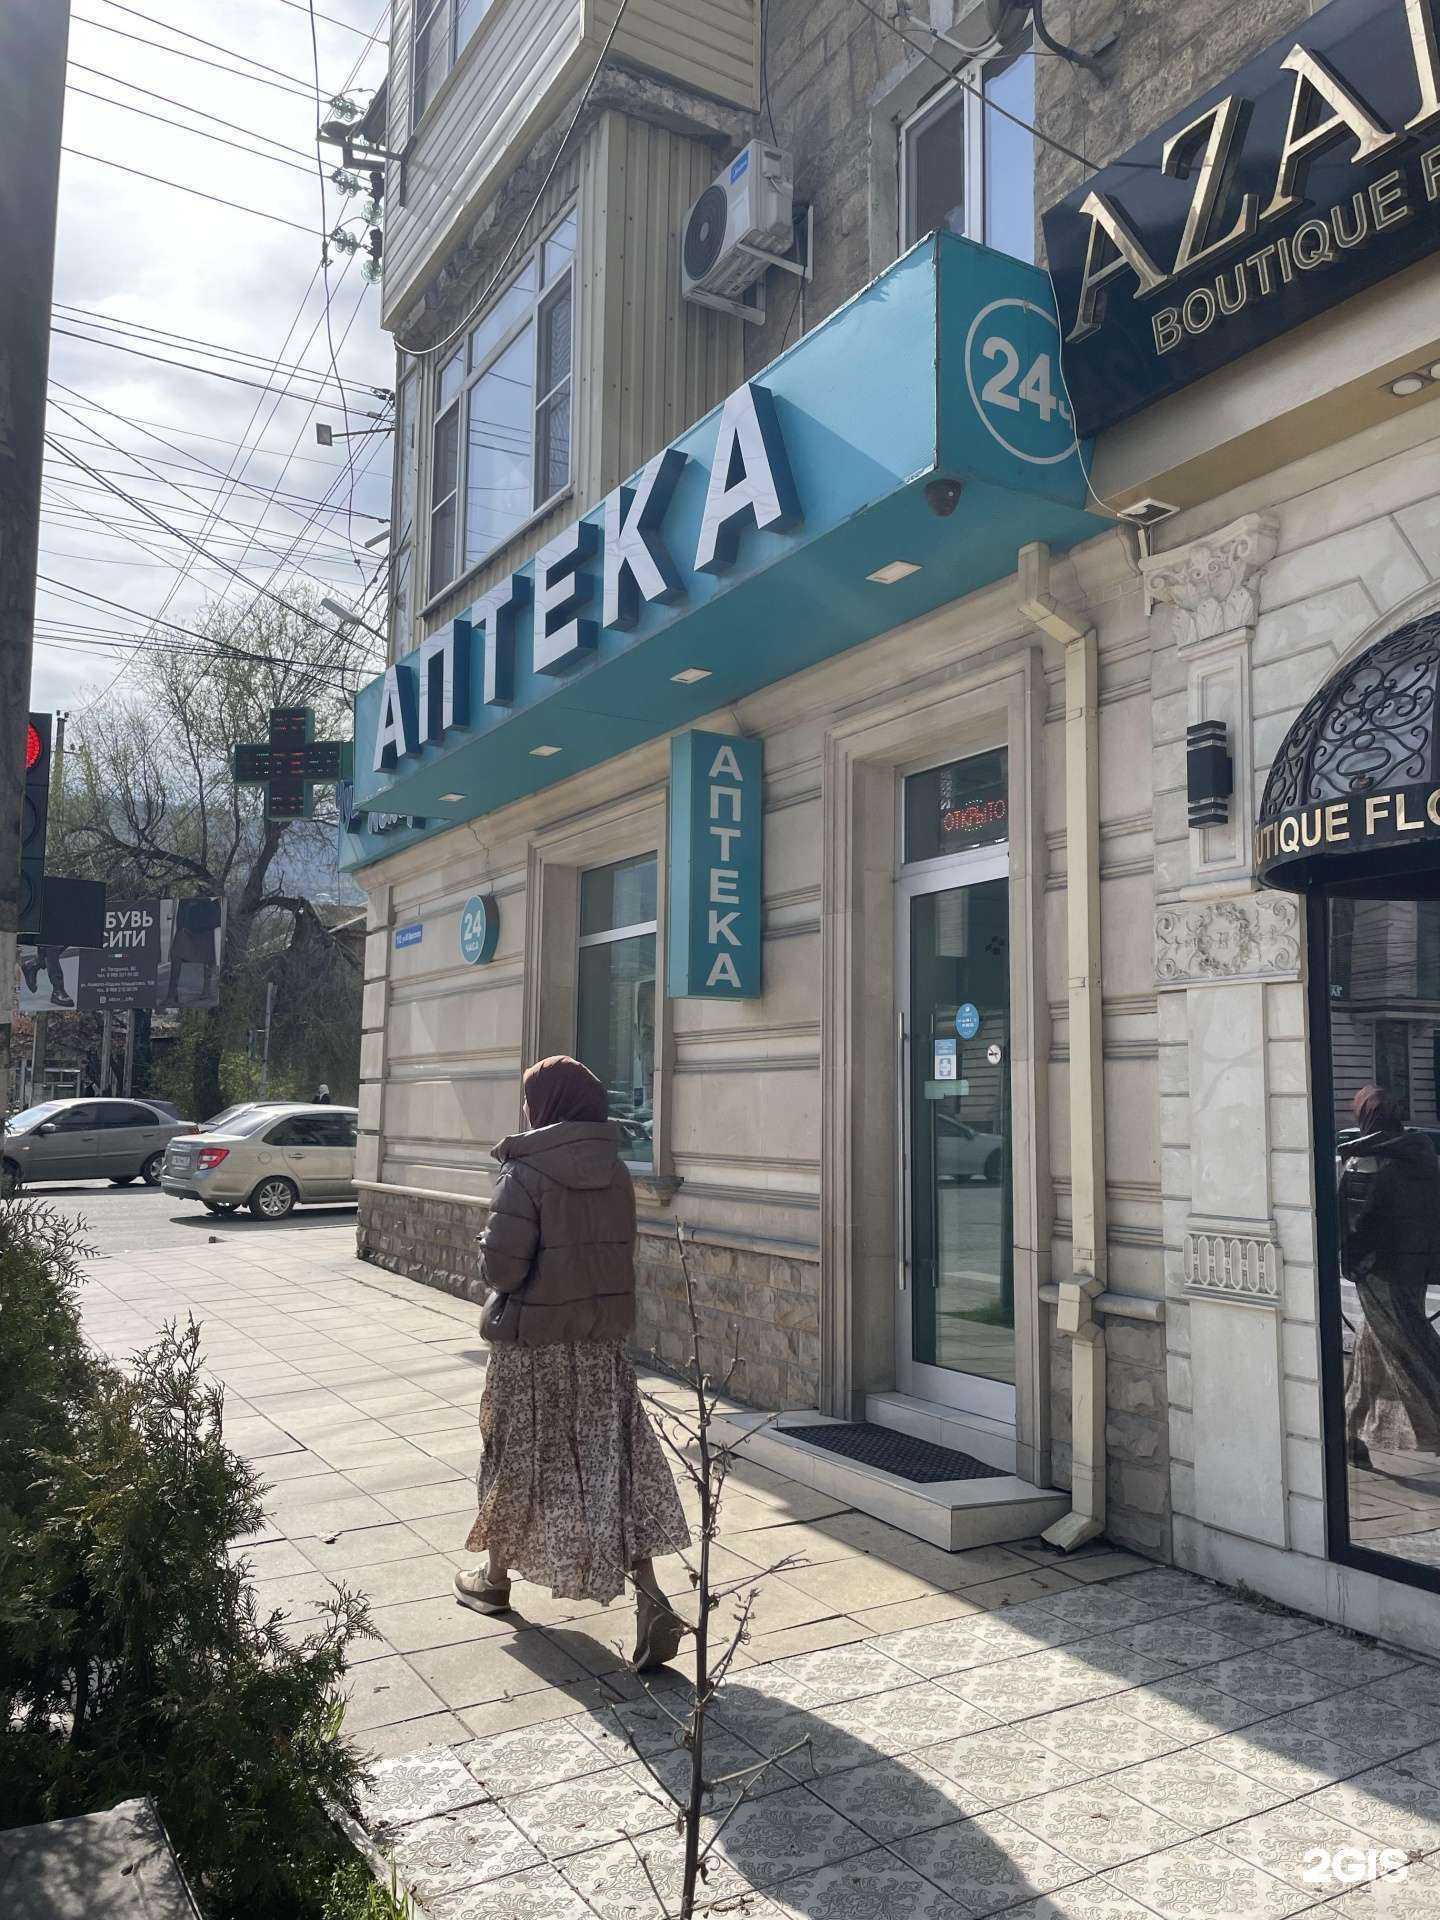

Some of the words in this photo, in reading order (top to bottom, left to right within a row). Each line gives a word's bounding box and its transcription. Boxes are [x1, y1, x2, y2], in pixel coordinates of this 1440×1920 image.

[1151, 170, 1408, 356] BOUTIQUE
[373, 382, 800, 772] АПТЕКА
[463, 910, 481, 940] 24
[706, 745, 744, 988] АПТЕКА
[1254, 803, 1350, 865] UTIQUE
